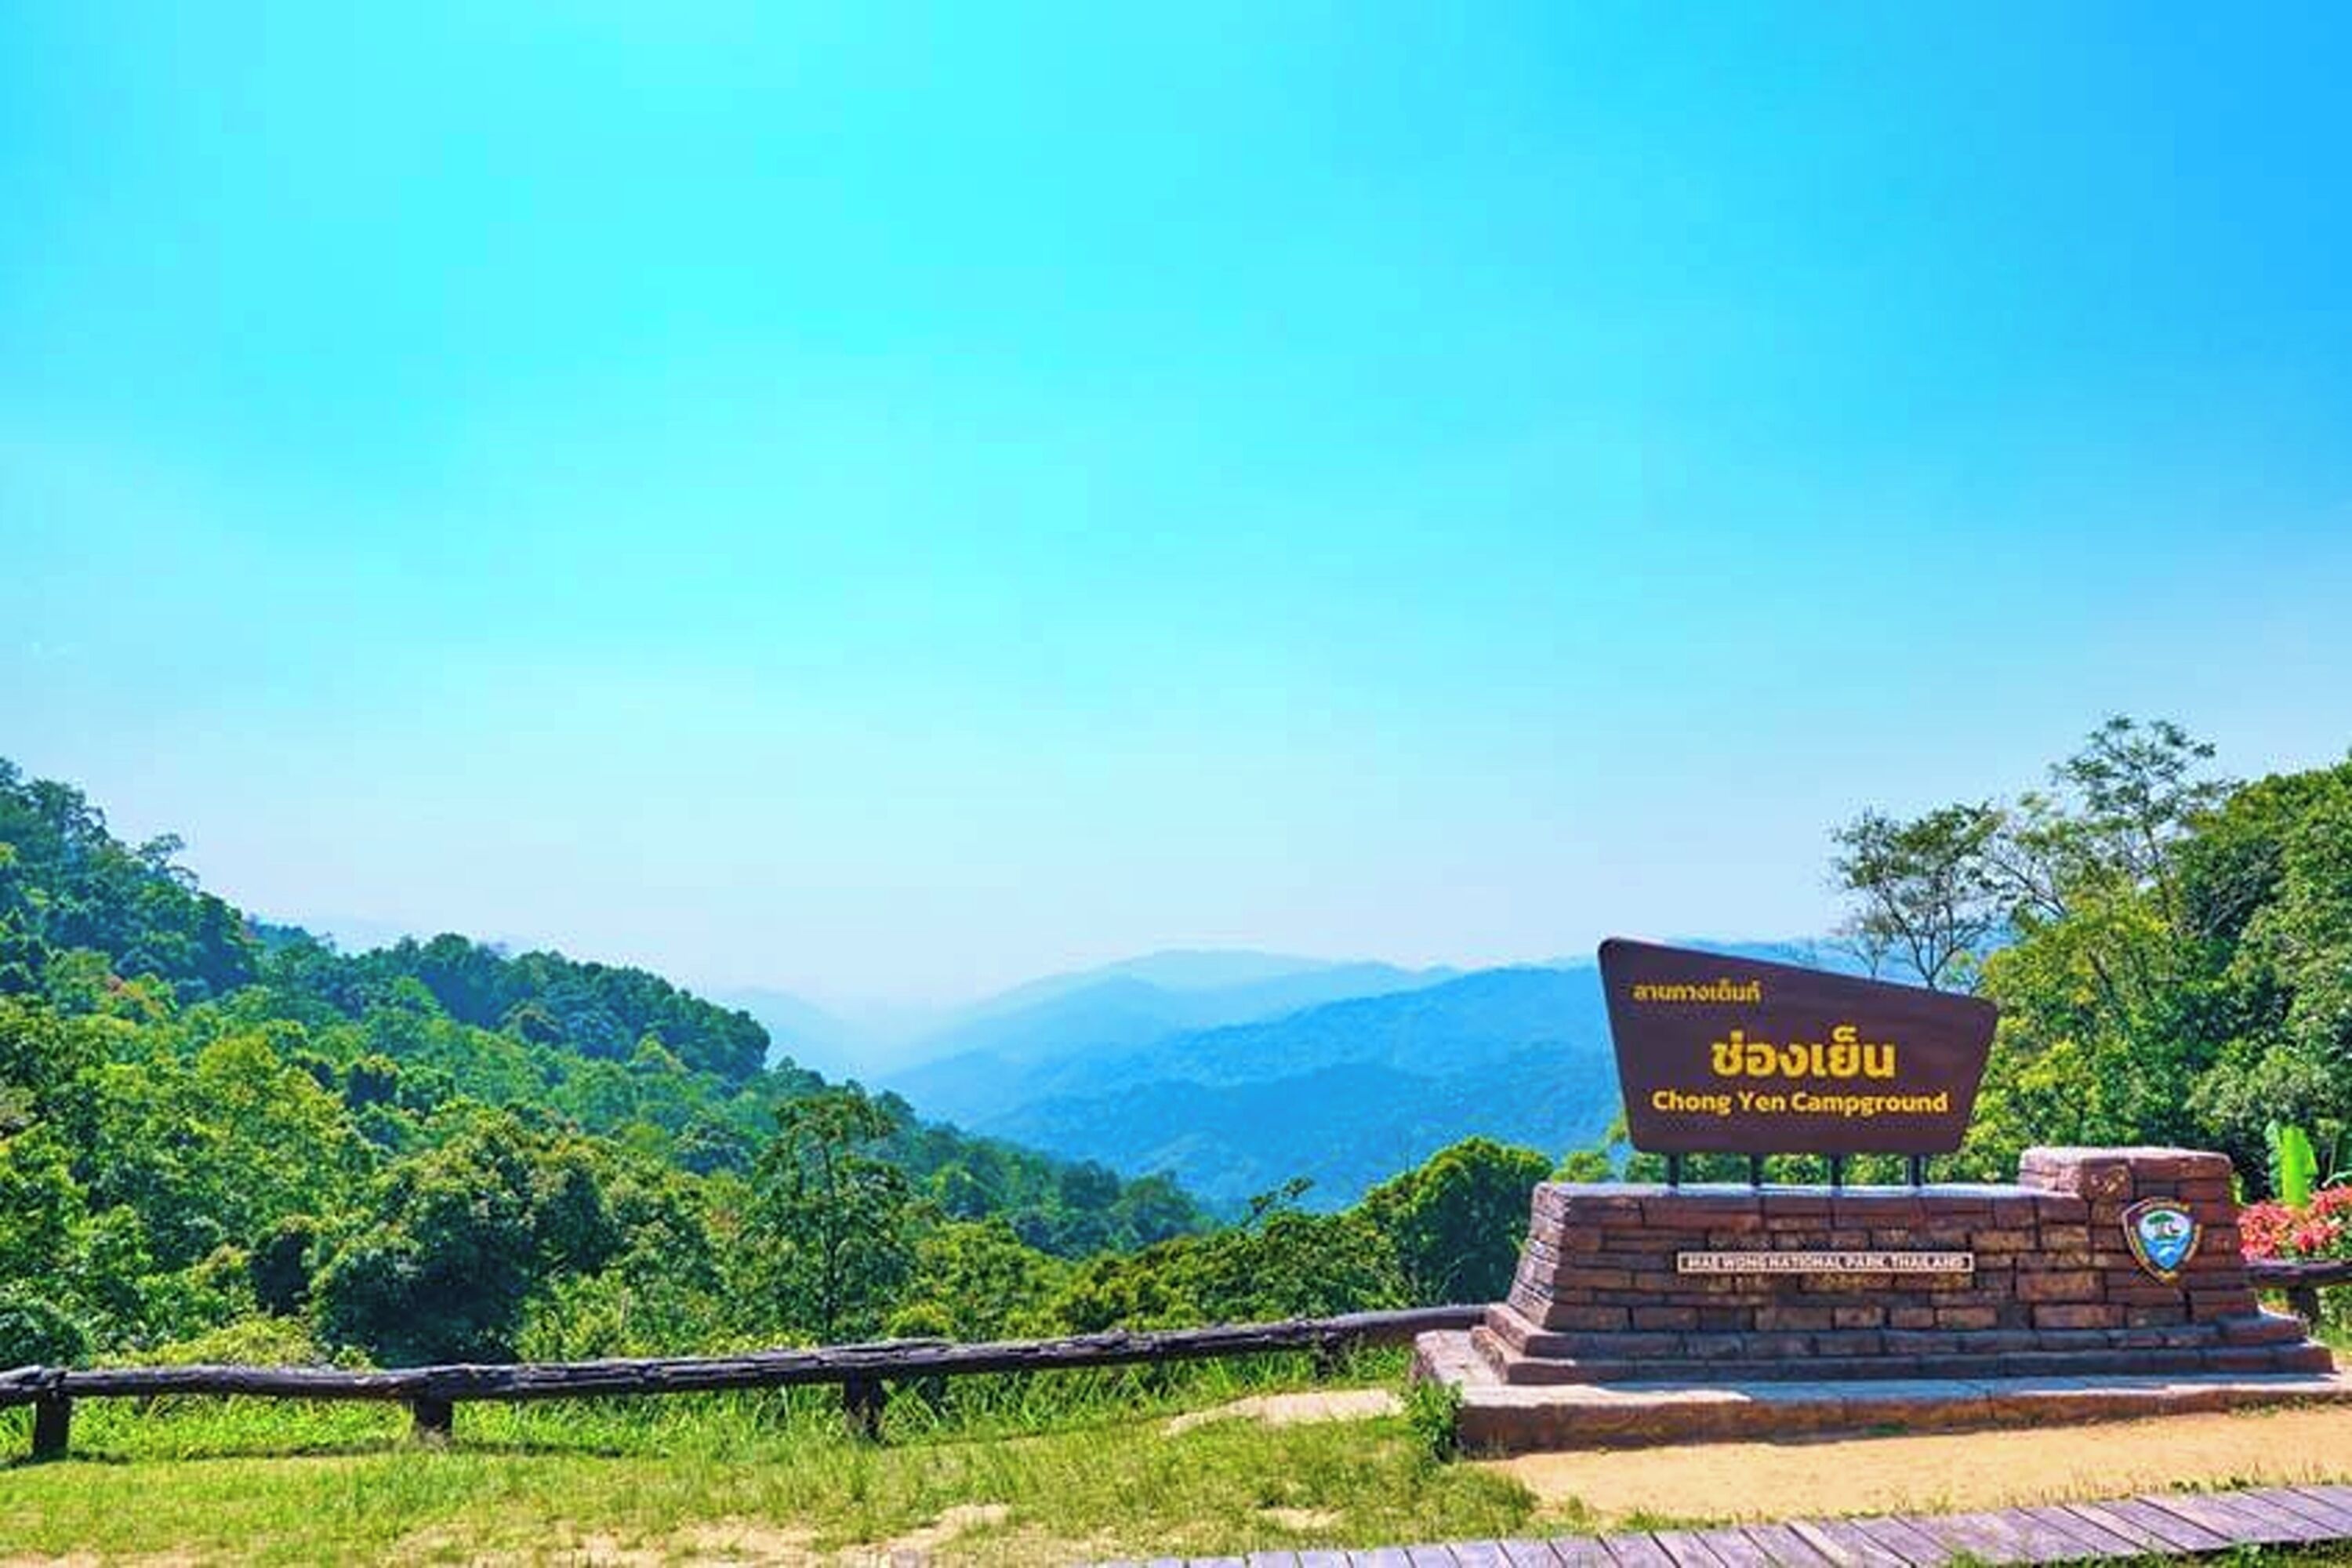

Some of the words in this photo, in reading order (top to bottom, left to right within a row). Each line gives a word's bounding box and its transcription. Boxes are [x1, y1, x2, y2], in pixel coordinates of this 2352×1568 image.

[1711, 1025, 1896, 1078] ช่องเย็น
[1652, 1090, 1732, 1116] Chong
[1737, 1091, 1786, 1112] Yen
[1791, 1091, 1948, 1117] Campground
[1768, 1256, 1844, 1269] NATIONAL
